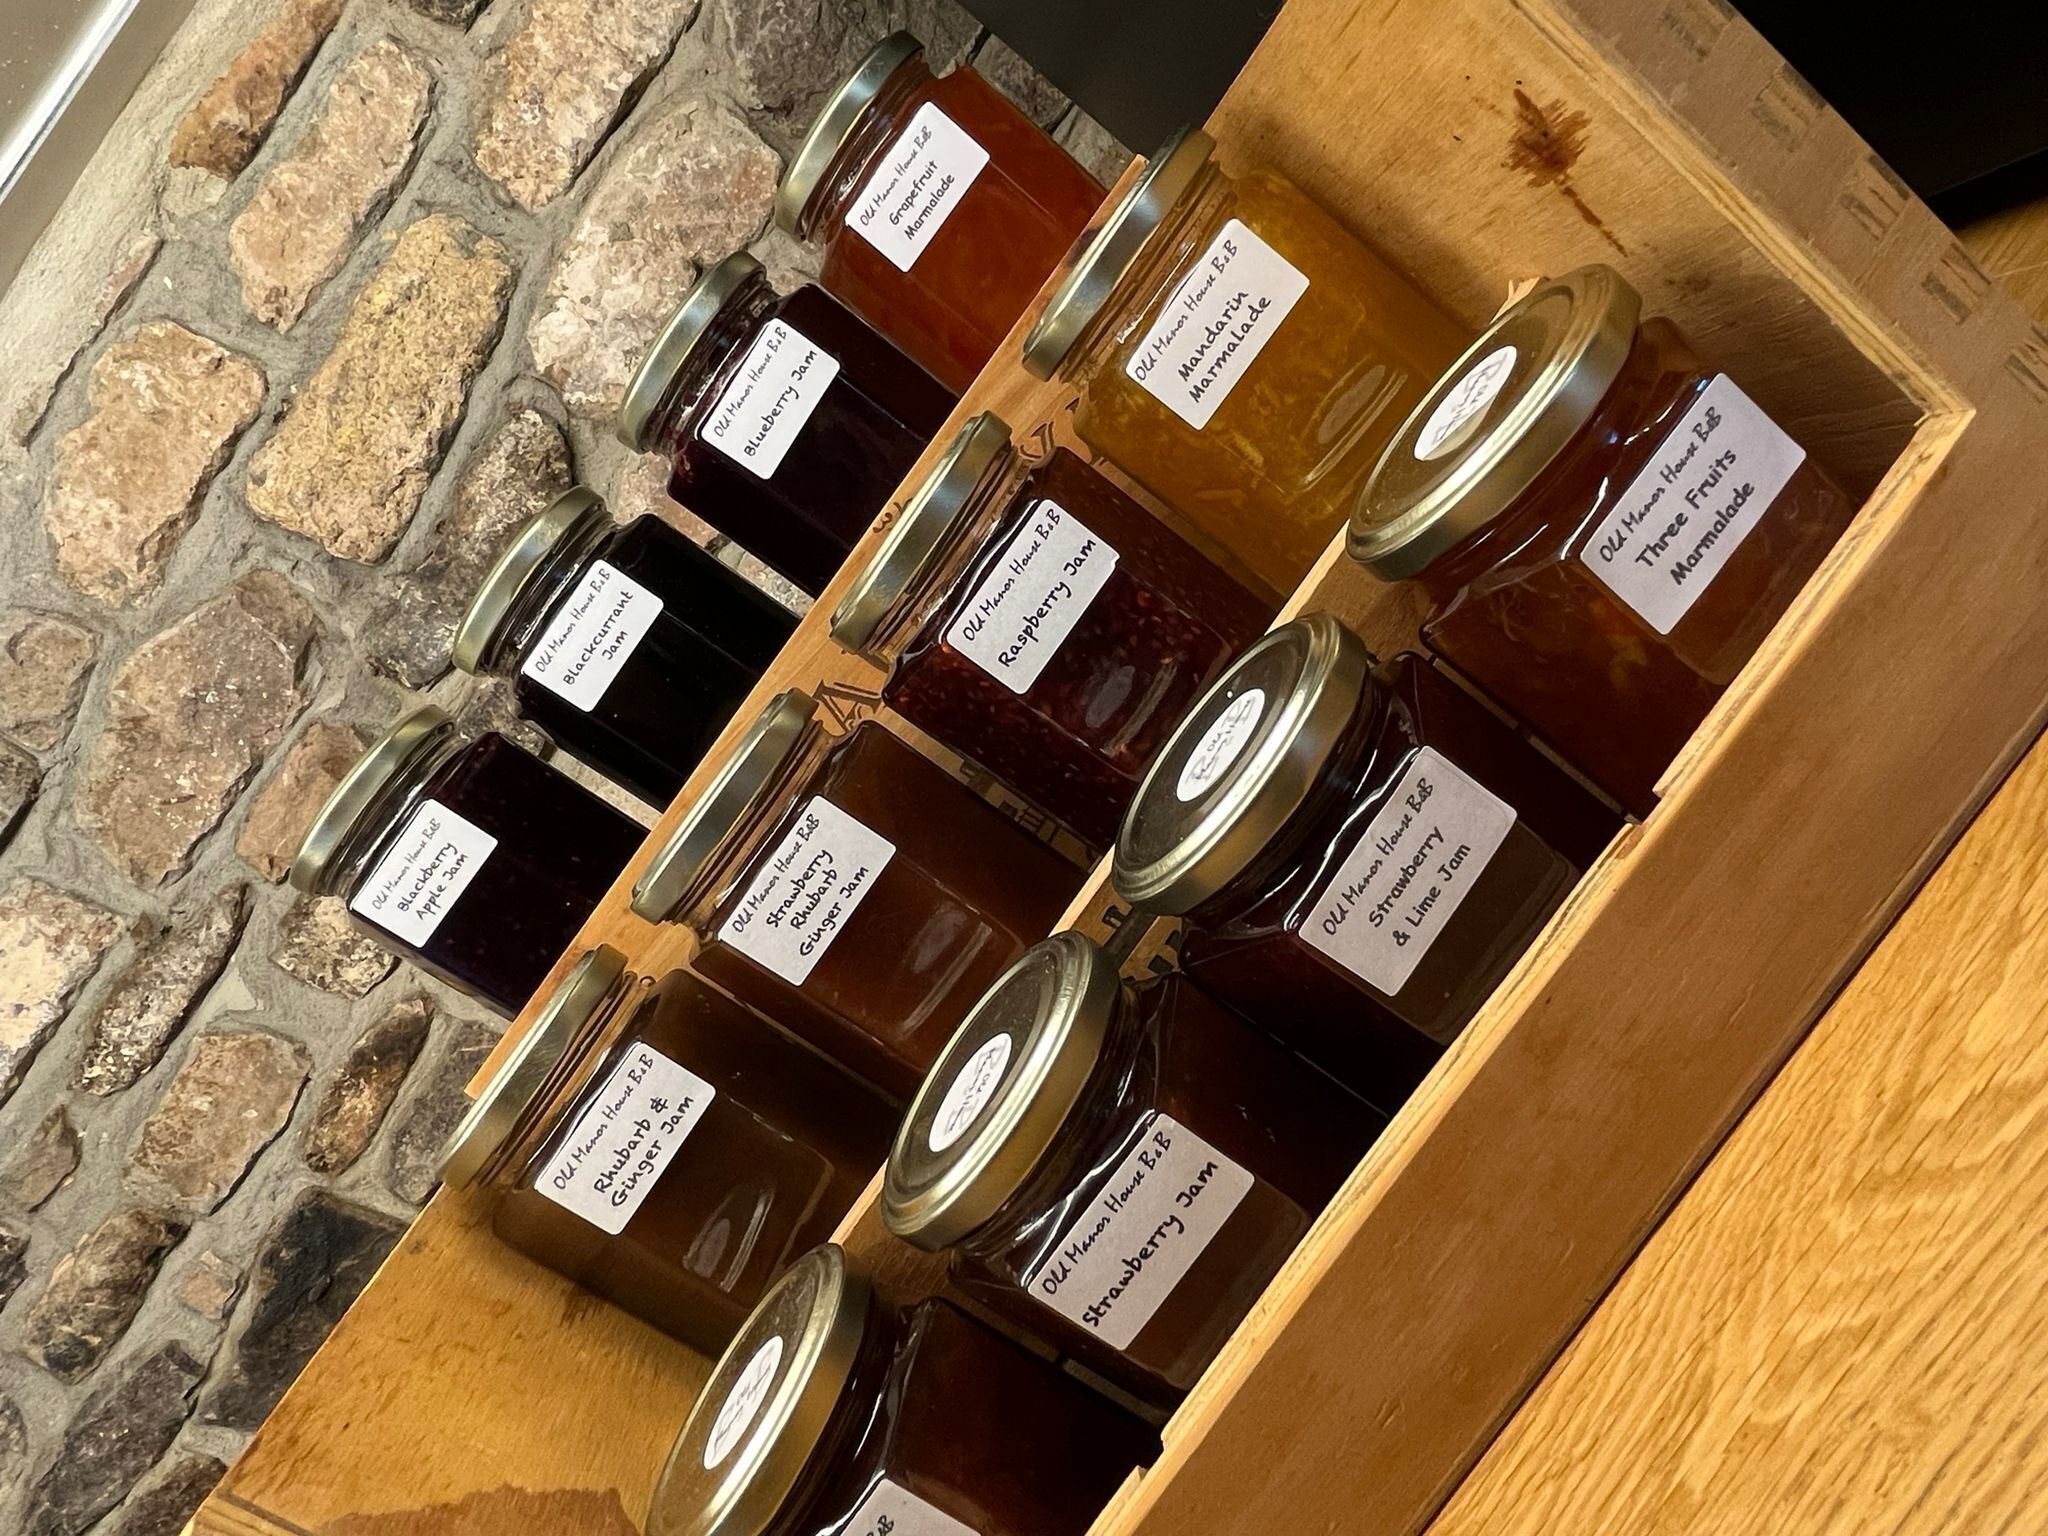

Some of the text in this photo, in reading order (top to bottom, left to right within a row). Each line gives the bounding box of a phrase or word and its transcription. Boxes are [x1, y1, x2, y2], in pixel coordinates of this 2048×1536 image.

[860, 206, 877, 226] Old
[873, 178, 899, 208] Manor
[895, 149, 918, 176] House
[889, 160, 938, 226] Grapefruit
[904, 174, 955, 240] Marmalade
[791, 350, 818, 381] Jam
[1134, 352, 1156, 381] Old
[1152, 314, 1189, 354] Manor
[1184, 274, 1216, 311] House
[1178, 292, 1248, 382] Mandarin
[1189, 297, 1272, 403] Marmalade
[714, 414, 731, 437] Old
[727, 385, 753, 416] Manor
[748, 353, 772, 382] House
[1599, 529, 1628, 562] Old
[1621, 486, 1666, 533] Manor
[1660, 442, 1699, 485] House
[1635, 449, 1737, 567] Three Fruits
[1670, 482, 1755, 585] Marmalade
[535, 652, 553, 672] Old
[551, 623, 576, 653] Manor
[571, 594, 595, 620] House
[563, 590, 634, 685] Blackcurrant
[963, 613, 985, 641] Old
[980, 577, 1015, 616] Manor
[1009, 540, 1041, 575] House
[998, 540, 1096, 667] Raspberry Jam
[602, 631, 629, 660] Jam
[372, 890, 389, 910] Old
[398, 843, 457, 912] Blackberry
[416, 854, 468, 920] Apple Jam
[732, 907, 753, 933] Old
[749, 875, 780, 910] Manor
[774, 841, 802, 873] House
[766, 849, 834, 927] Strawberry
[790, 868, 838, 930] Rhubarb
[799, 867, 868, 956] Ginger Jam
[1322, 902, 1349, 936] Old
[1341, 859, 1383, 906] Manor
[1376, 814, 1413, 856] House
[1368, 826, 1445, 928] Strawberry
[1392, 844, 1472, 947] & Lime Jam
[553, 1162, 577, 1190] Old
[572, 1125, 608, 1163] Manor
[602, 1085, 634, 1120] House
[594, 1097, 669, 1193] Rhubarb &
[611, 1096, 694, 1207] Ginger Jam
[1042, 1261, 1072, 1294] Old
[1064, 1216, 1111, 1264] Manor
[1104, 1170, 1145, 1213] House
[1082, 1161, 1219, 1327] Strawberry Jam
